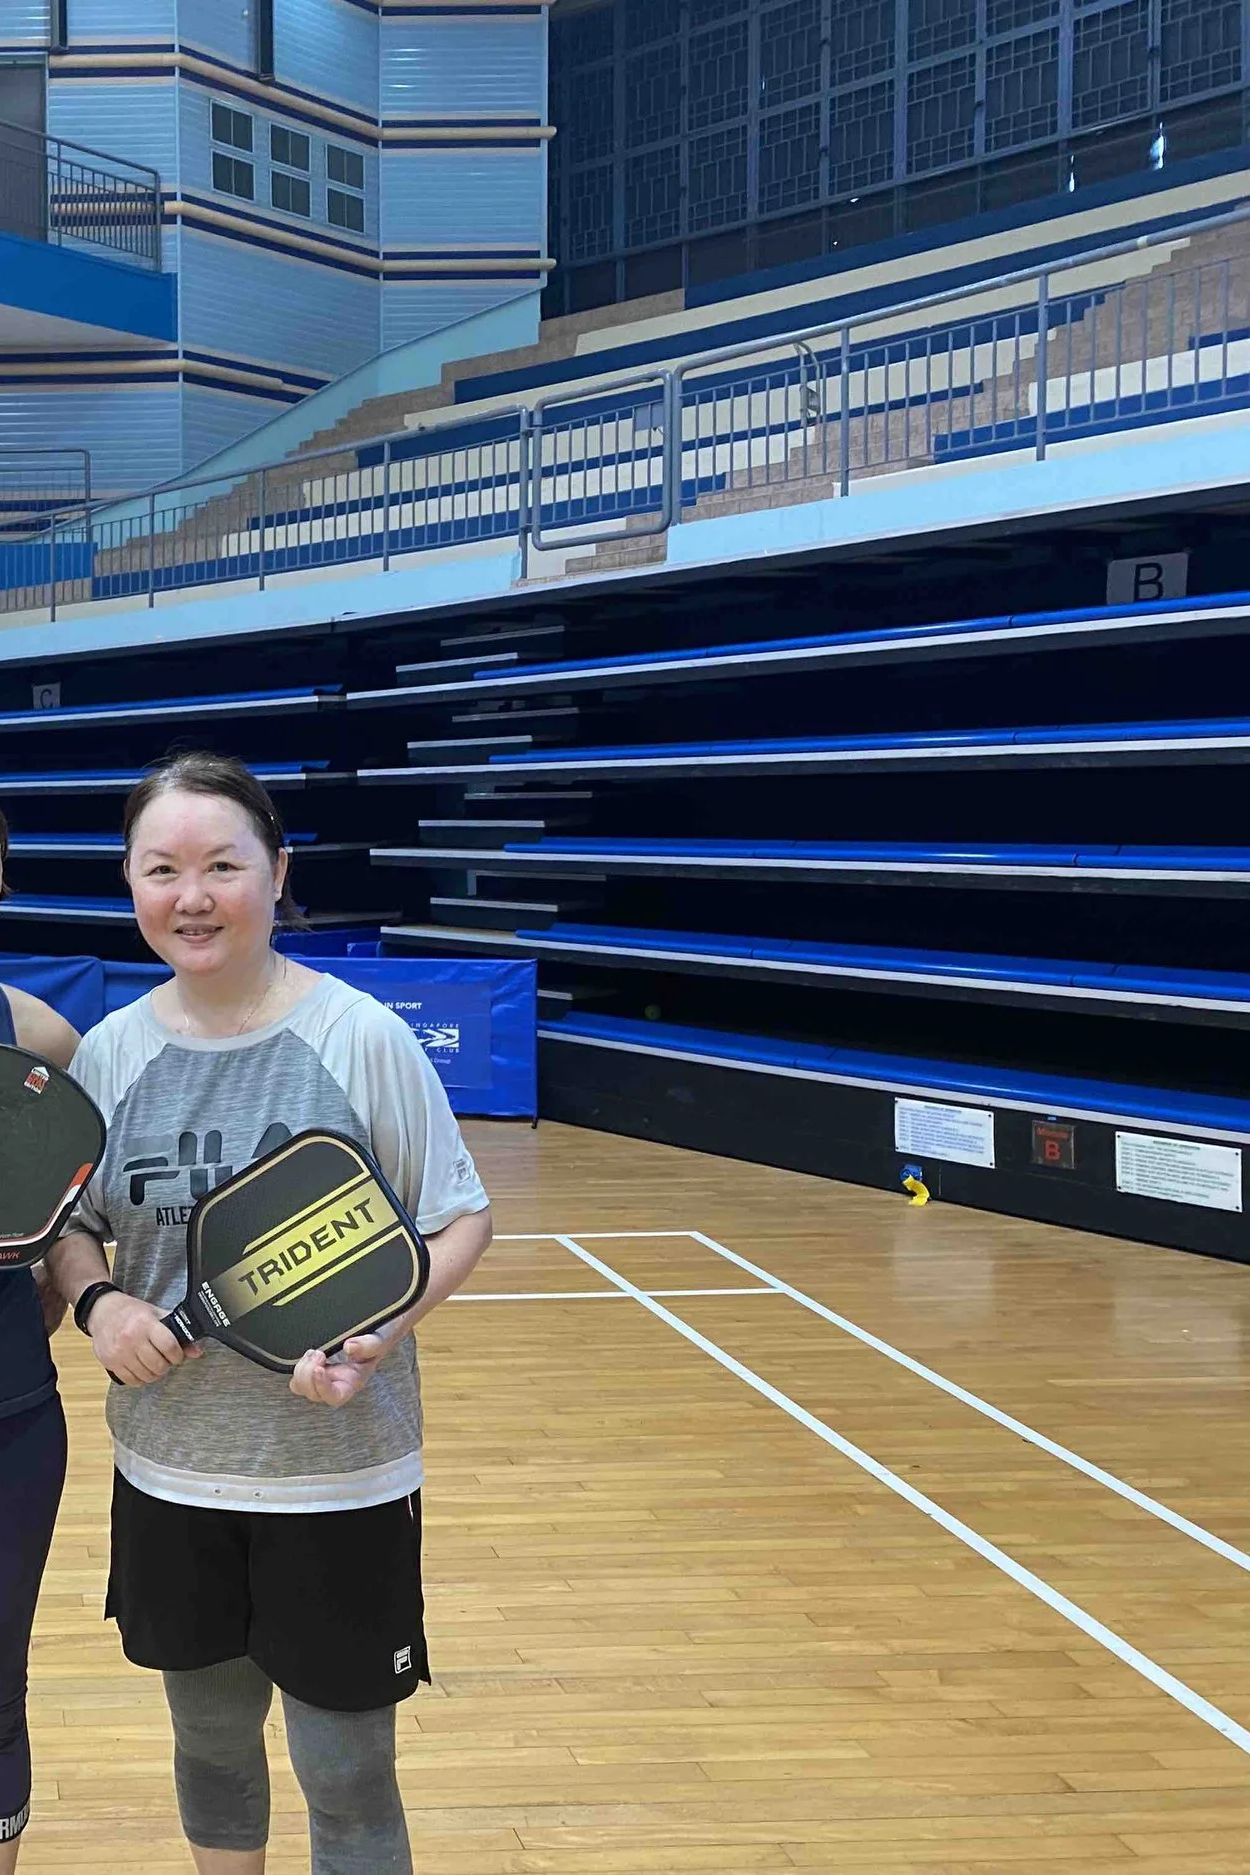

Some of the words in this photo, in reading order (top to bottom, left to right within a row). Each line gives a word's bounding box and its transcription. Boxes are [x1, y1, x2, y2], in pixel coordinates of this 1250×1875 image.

[1134, 562, 1164, 601] B
[40, 689, 53, 709] C
[238, 1197, 375, 1296] TRIDENT
[201, 1281, 231, 1327] ENGAGE
